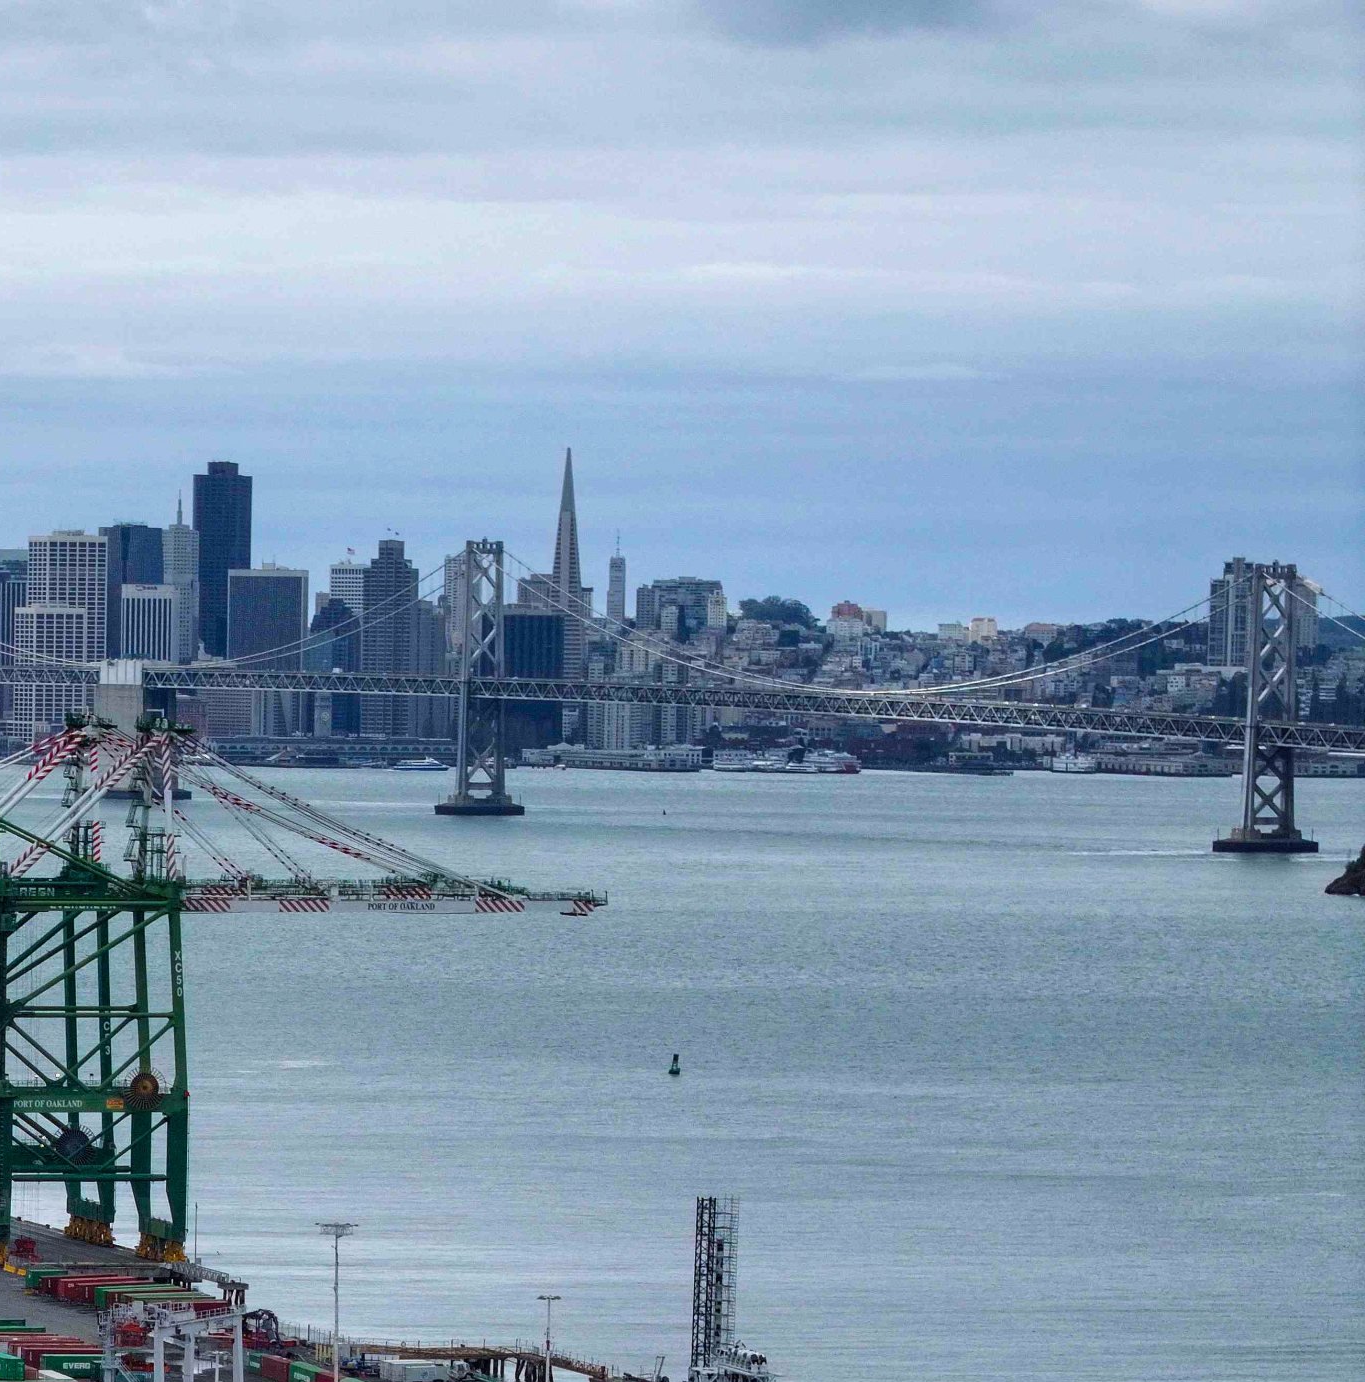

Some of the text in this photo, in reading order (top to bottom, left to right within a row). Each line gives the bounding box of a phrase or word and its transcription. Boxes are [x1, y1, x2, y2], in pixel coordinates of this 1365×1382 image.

[368, 902, 435, 911] PORT OF OAKLAND
[174, 951, 184, 997] XC50
[14, 1099, 83, 1108] PORT OF OAKLAND
